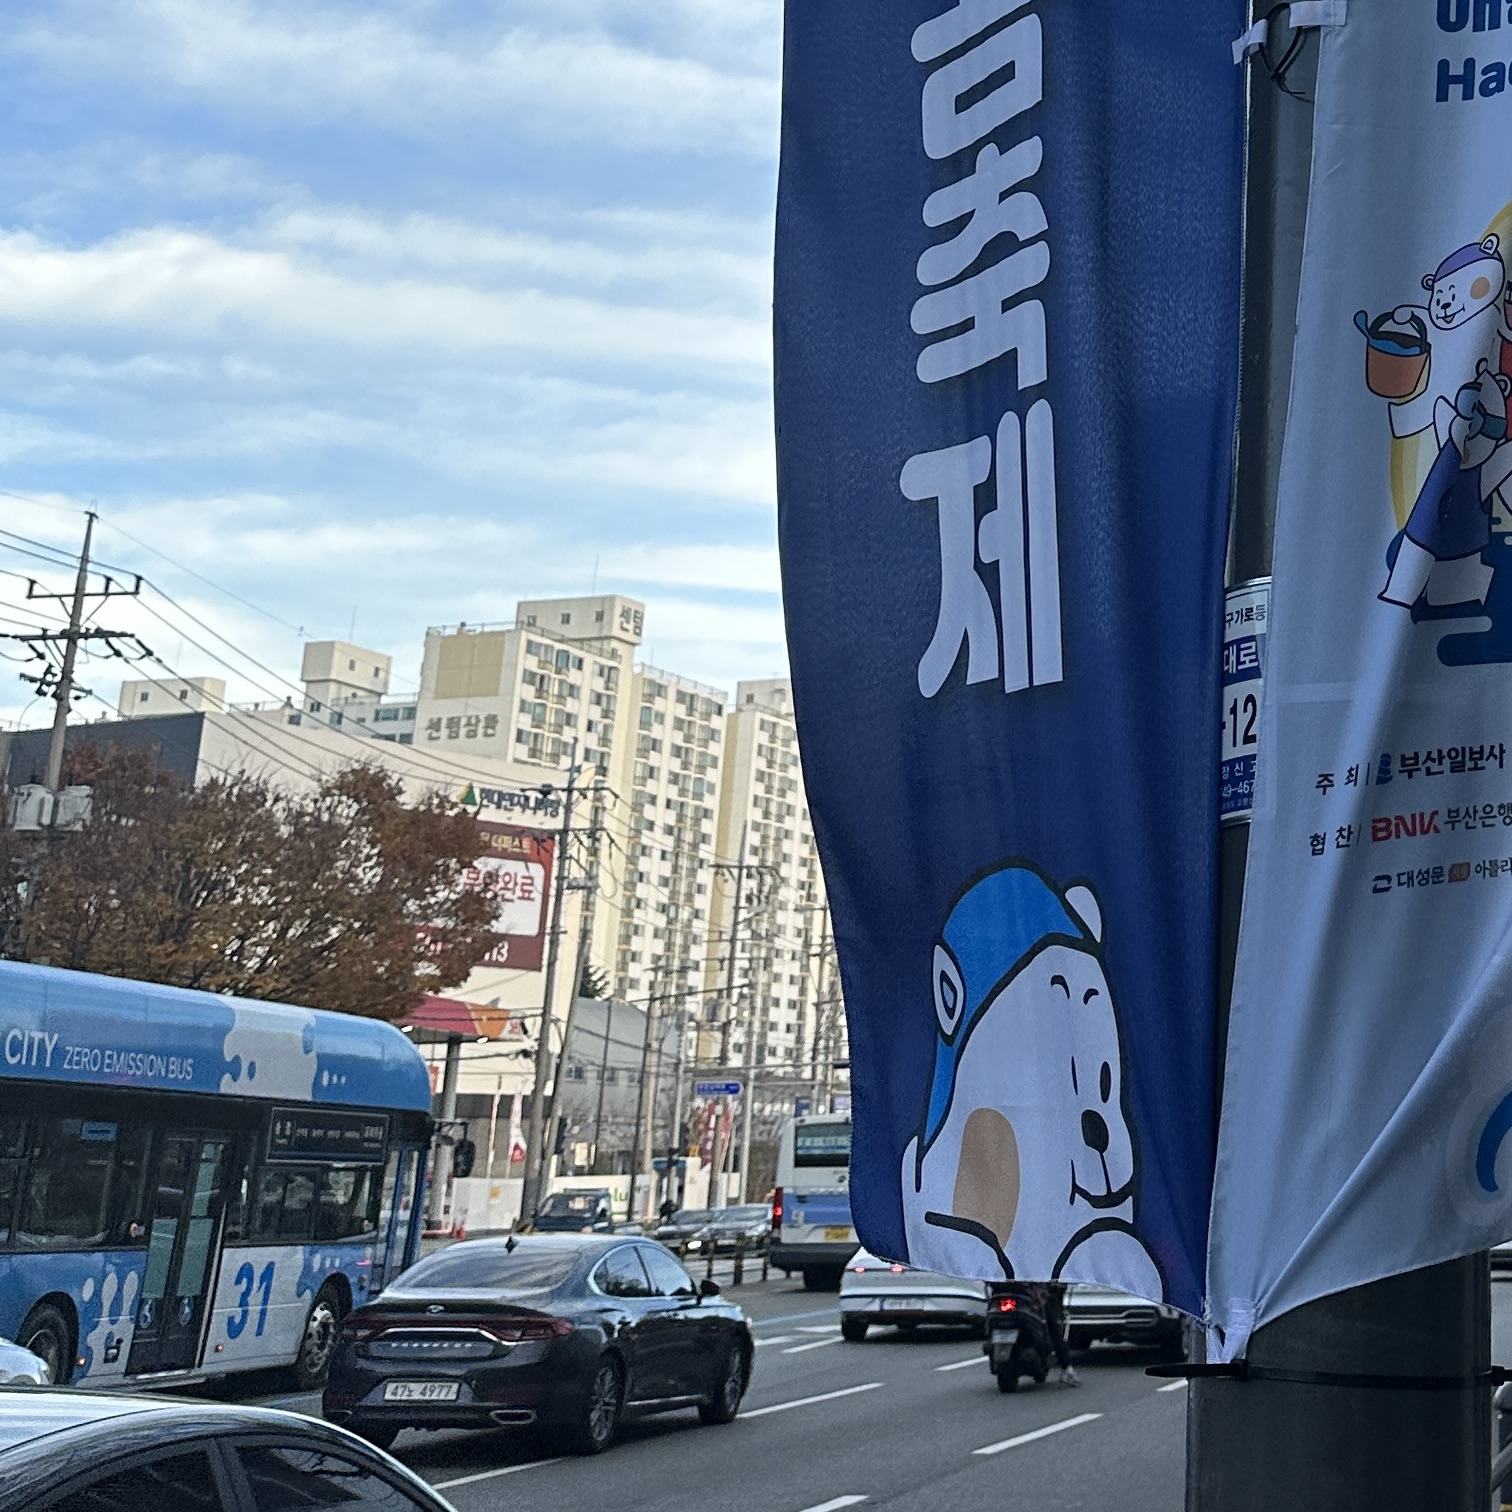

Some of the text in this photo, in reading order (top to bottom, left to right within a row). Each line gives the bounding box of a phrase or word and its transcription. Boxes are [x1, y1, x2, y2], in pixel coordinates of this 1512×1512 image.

[1399, 743, 1506, 779] 부산일보사
[1371, 810, 1441, 843] BNK
[463, 867, 535, 903] 분완료
[1396, 865, 1444, 888] 대성문
[5, 1028, 195, 1080] CITY ZERO EMISSION BUS
[226, 1261, 277, 1340] 31
[419, 1384, 453, 1398] 4977
